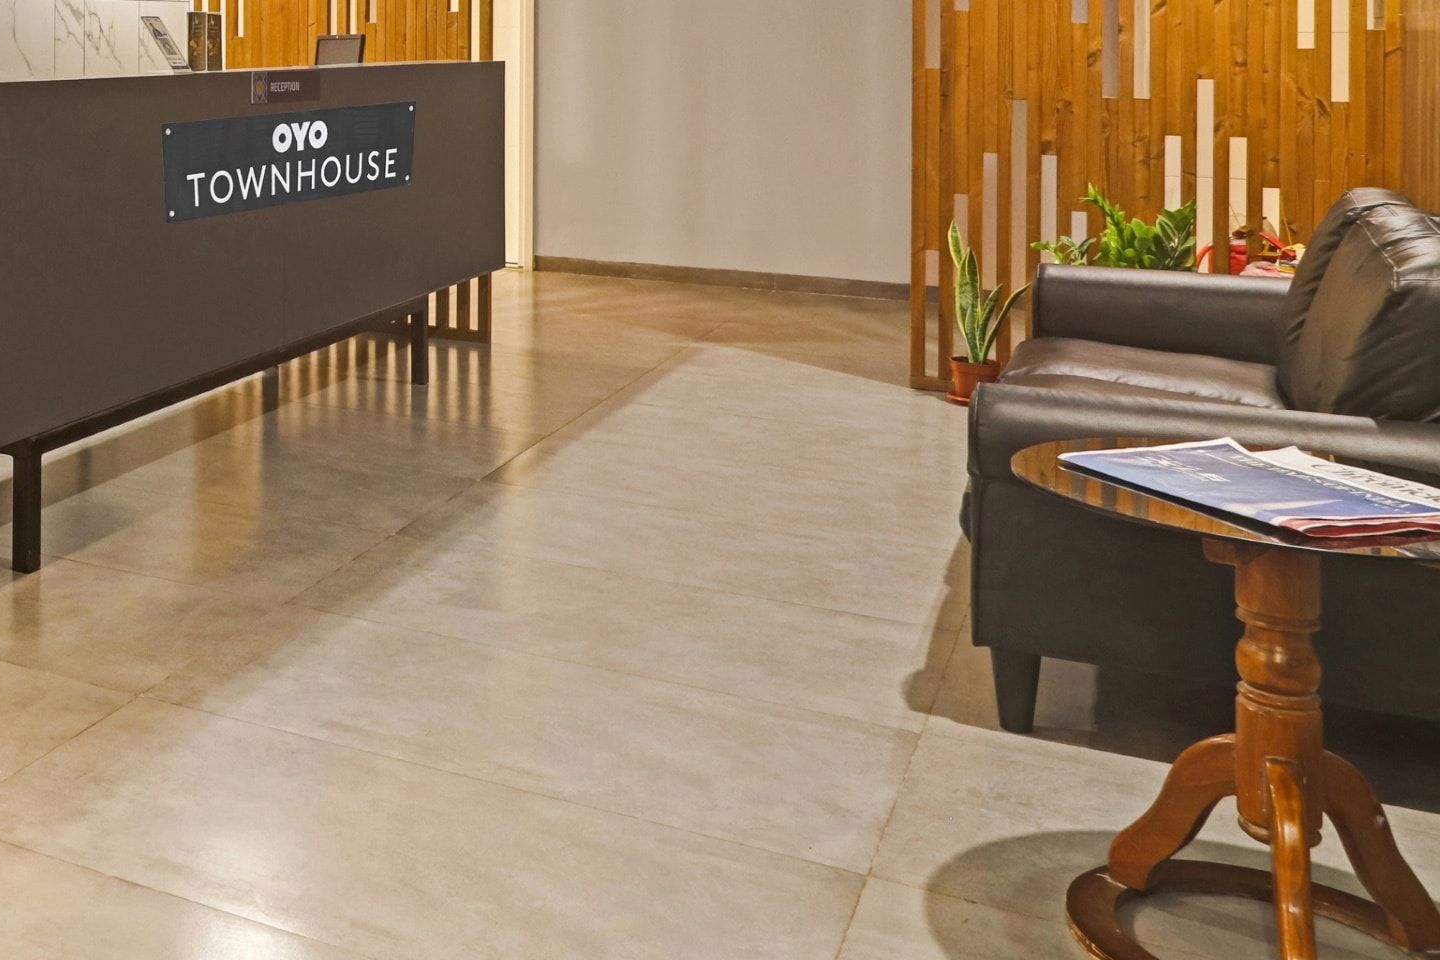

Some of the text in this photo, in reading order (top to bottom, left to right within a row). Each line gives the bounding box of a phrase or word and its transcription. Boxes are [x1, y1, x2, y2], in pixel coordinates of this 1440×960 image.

[270, 81, 300, 92] RECEPTION
[272, 120, 328, 153] OYO
[186, 148, 398, 207] TOWNHOUSE
